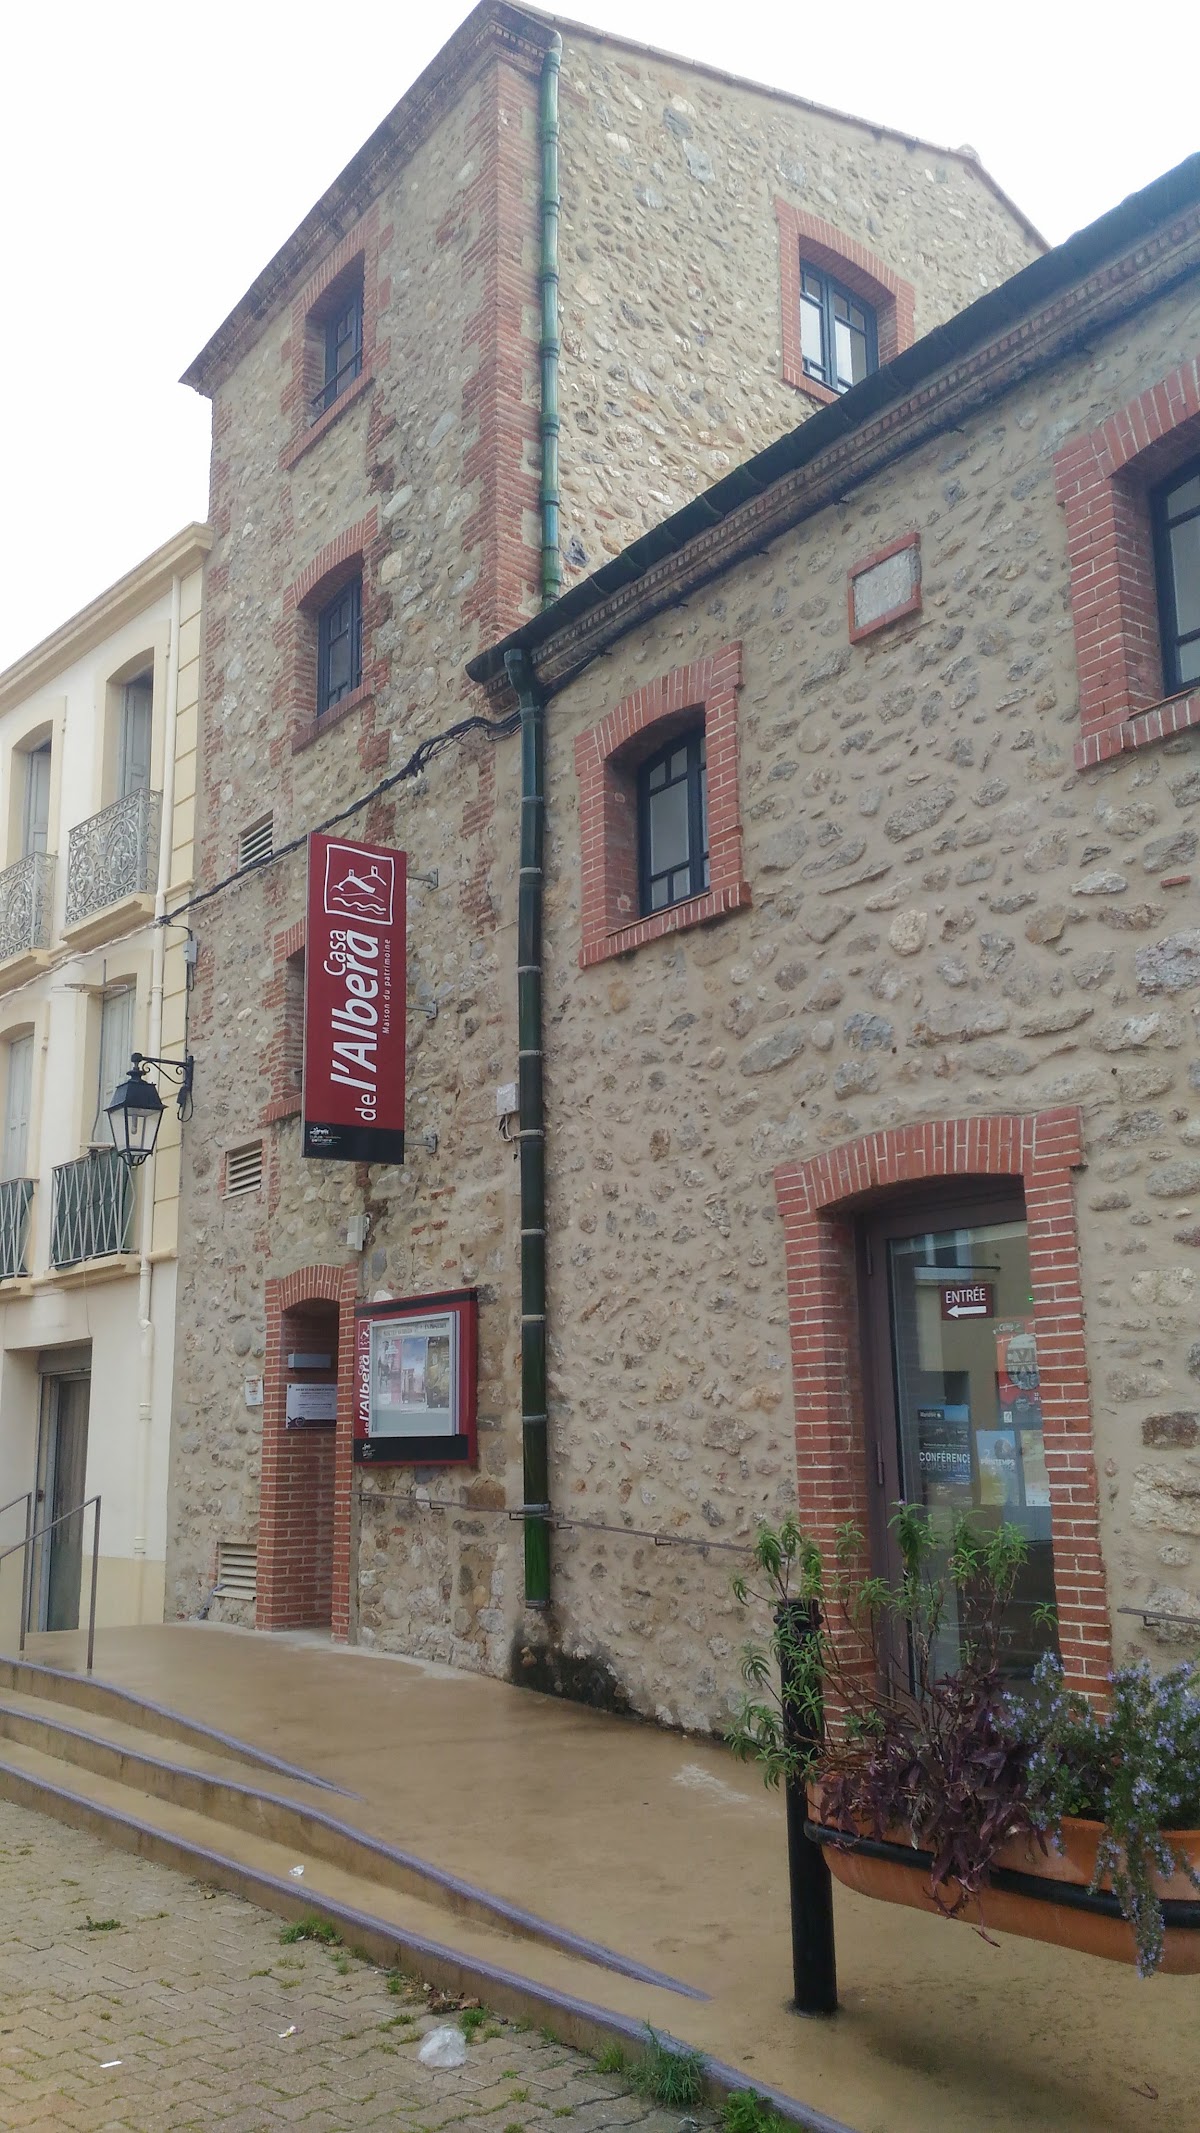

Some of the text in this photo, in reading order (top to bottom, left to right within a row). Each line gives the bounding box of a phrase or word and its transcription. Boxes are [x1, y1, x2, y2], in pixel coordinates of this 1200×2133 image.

[323, 929, 347, 976] Casa
[382, 938, 391, 1034] Maison du patrimoine
[330, 929, 379, 1121] de l'Albera
[945, 1286, 987, 1304] ENTRÉE
[919, 1451, 971, 1464] CONFÉRENCE
